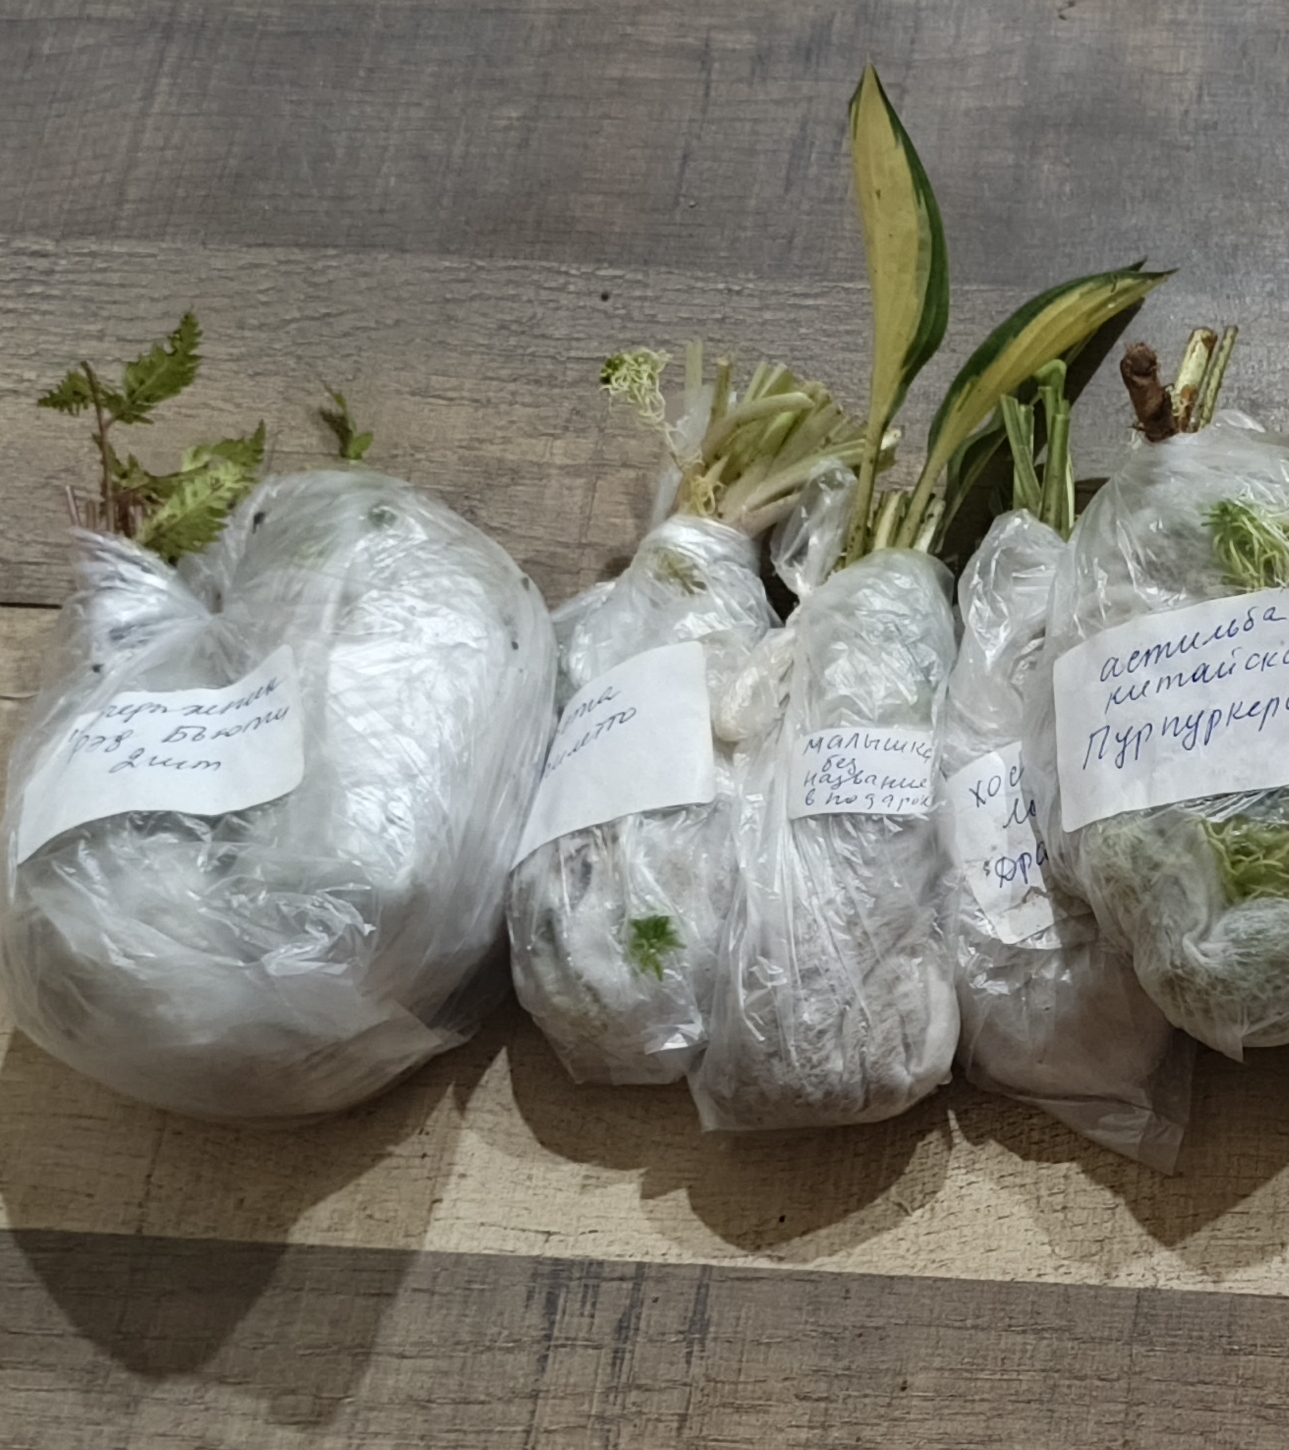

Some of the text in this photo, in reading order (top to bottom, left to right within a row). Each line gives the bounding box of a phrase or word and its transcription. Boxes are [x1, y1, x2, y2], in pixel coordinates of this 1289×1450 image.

[1100, 605, 1287, 682] астильба
[822, 754, 857, 775] без
[969, 766, 1025, 808] хос
